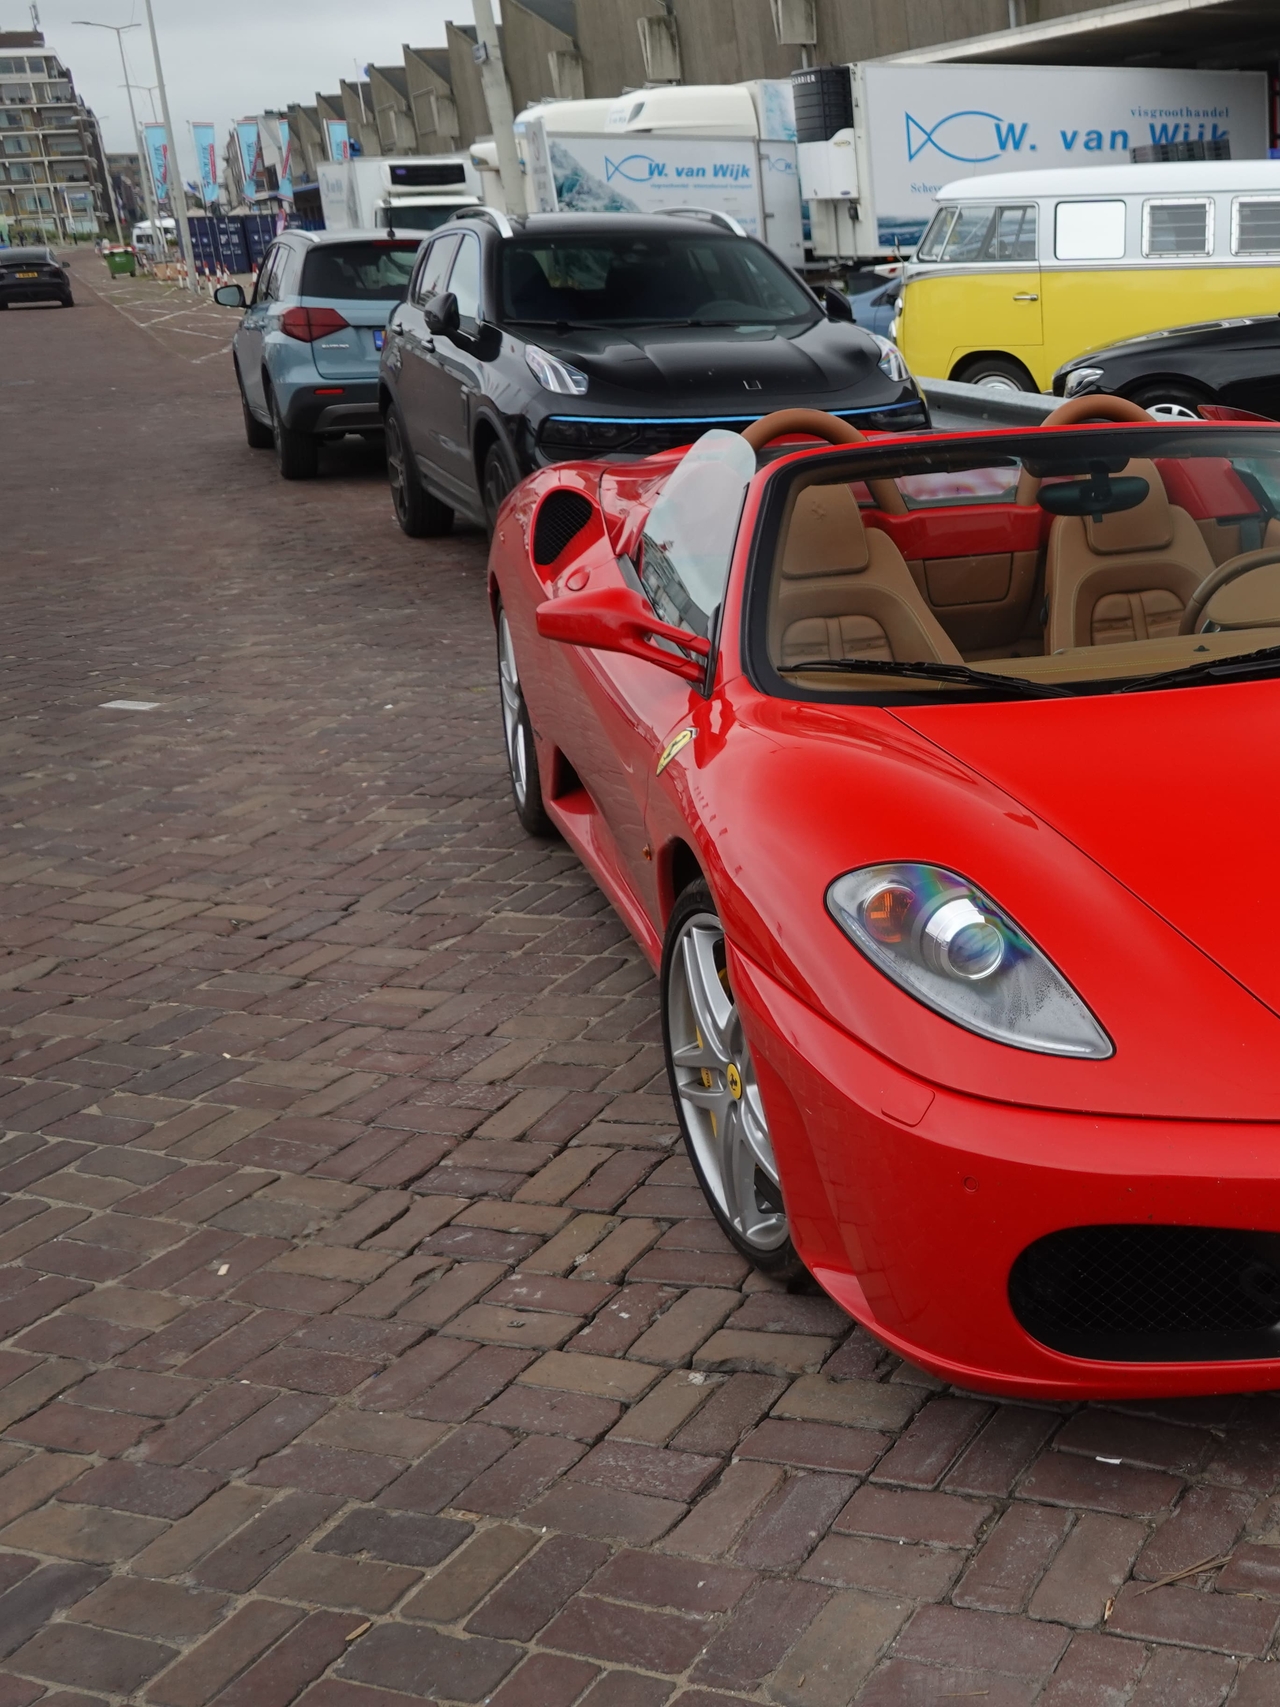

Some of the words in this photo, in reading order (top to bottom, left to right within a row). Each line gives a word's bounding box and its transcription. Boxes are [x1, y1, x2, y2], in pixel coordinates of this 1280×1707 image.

[1130, 106, 1229, 119] visgroothandel
[994, 122, 1037, 152] W.
[1060, 127, 1129, 151] van
[647, 163, 668, 177] W.
[675, 166, 706, 178] van
[713, 163, 751, 181] Wijk
